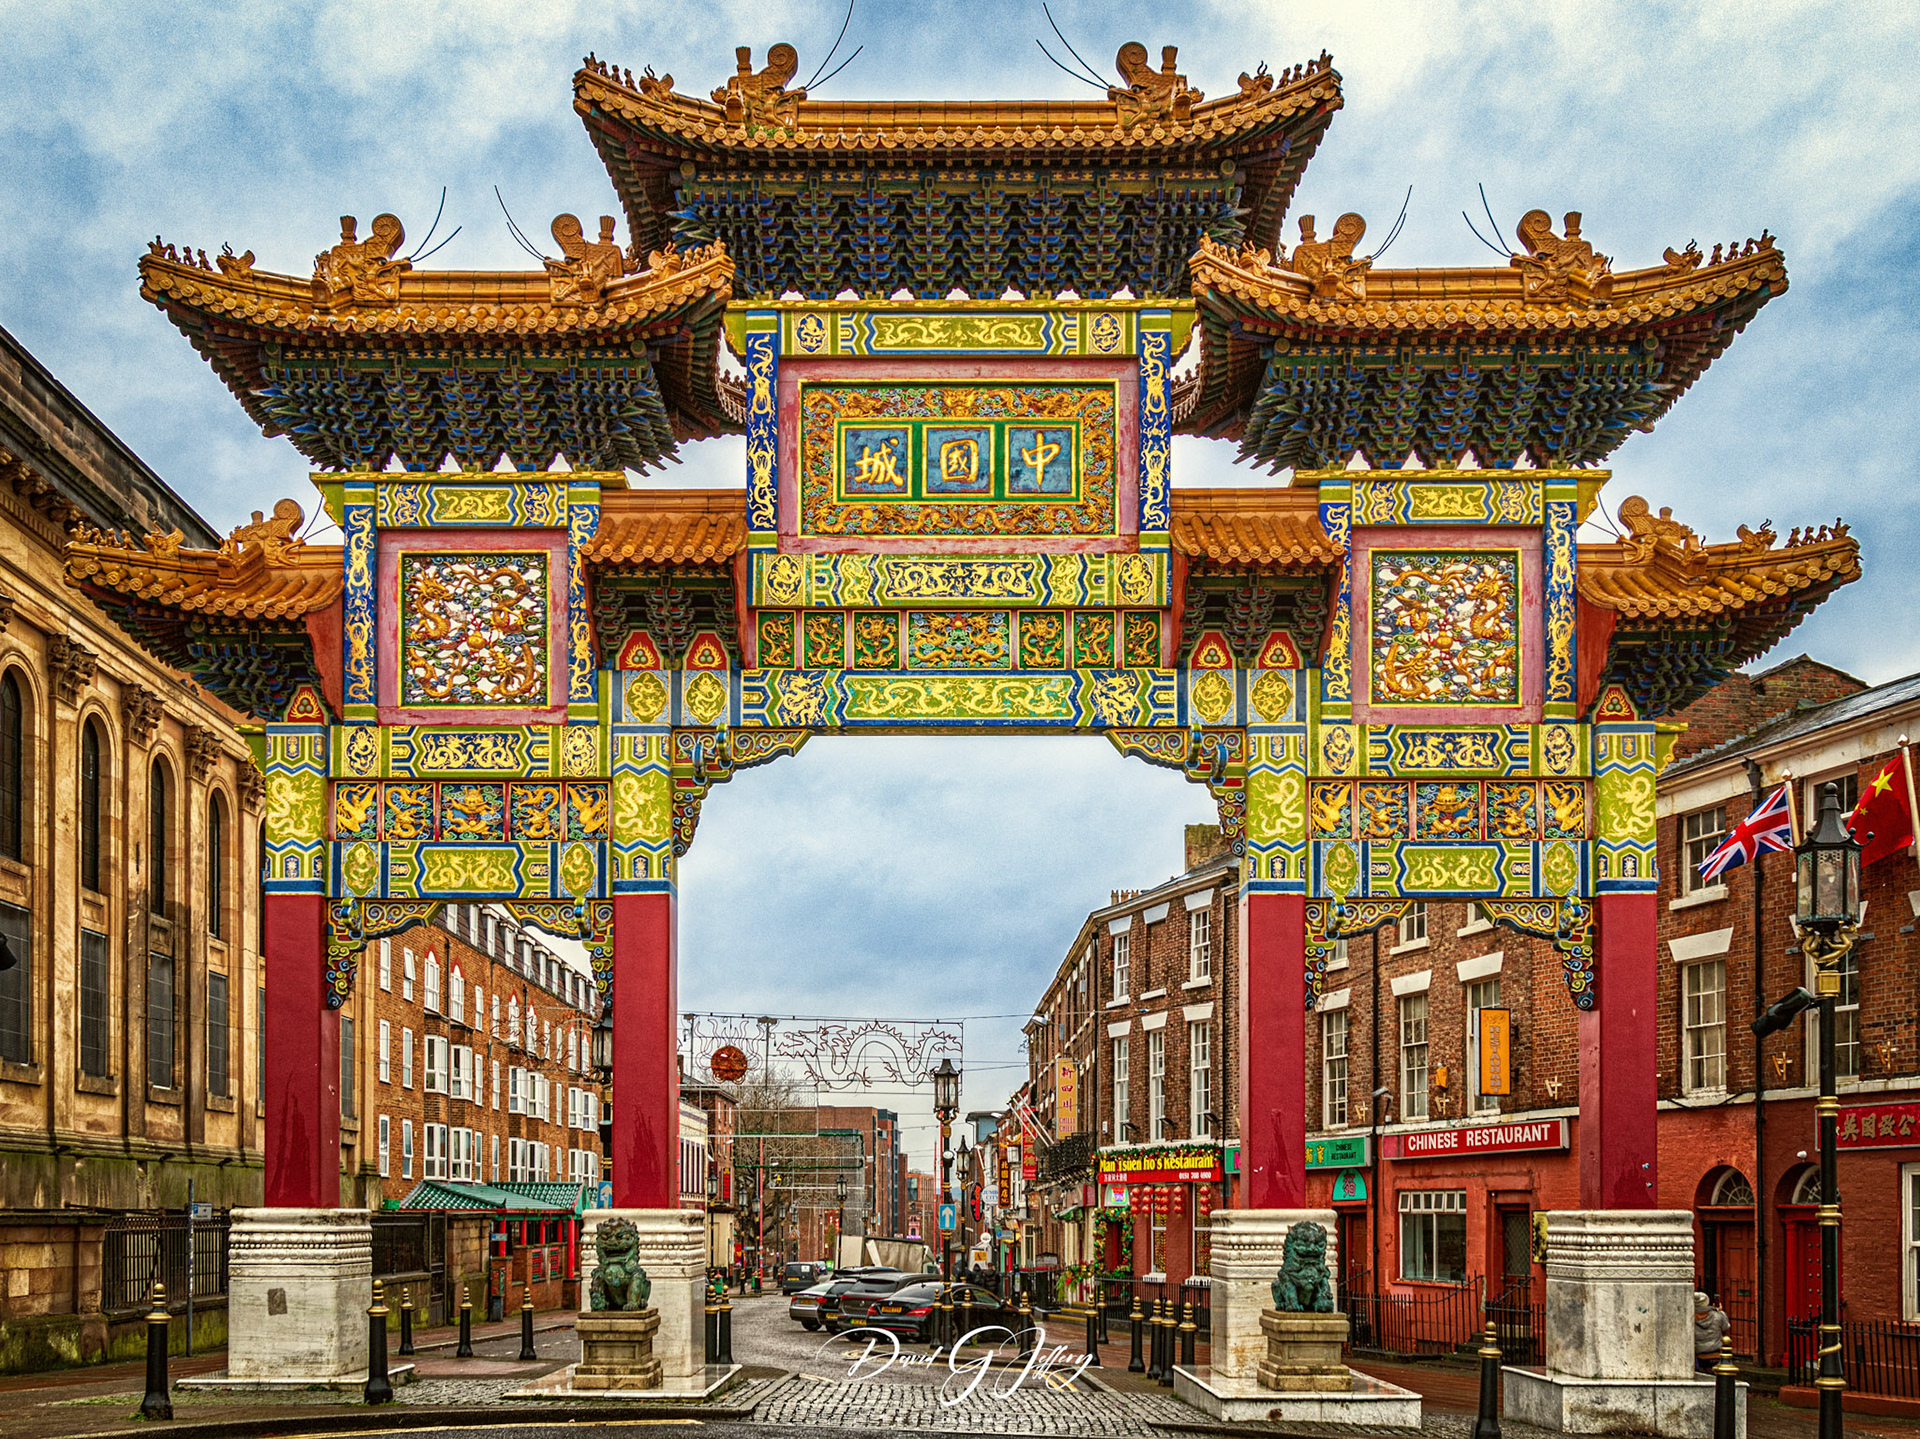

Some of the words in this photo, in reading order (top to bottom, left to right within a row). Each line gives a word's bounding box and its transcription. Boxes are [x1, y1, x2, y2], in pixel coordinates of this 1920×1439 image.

[1059, 1125, 1076, 1133] CHILLI
[1408, 1132, 1458, 1150] CHINESE
[1466, 1124, 1551, 1146] RESTAURANT
[1335, 1143, 1353, 1151] CHINESE
[1331, 1152, 1357, 1160] RESTAURANT
